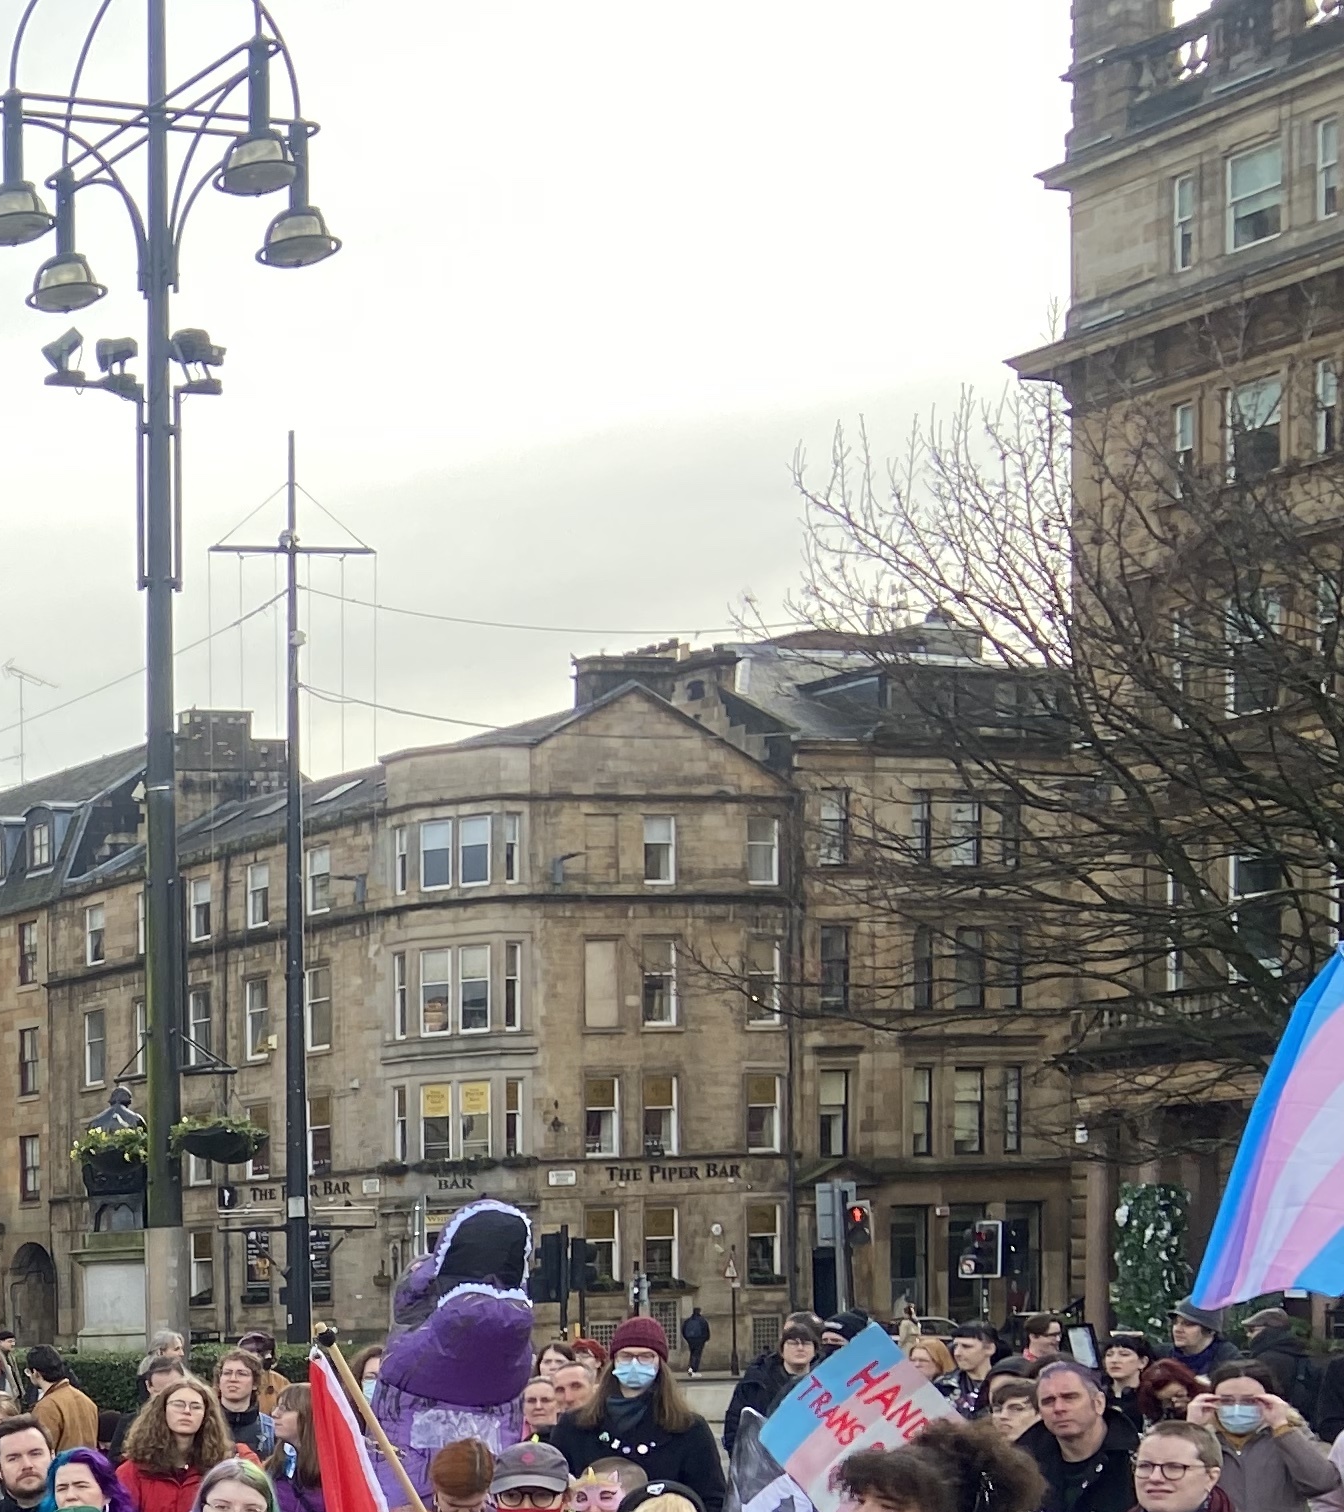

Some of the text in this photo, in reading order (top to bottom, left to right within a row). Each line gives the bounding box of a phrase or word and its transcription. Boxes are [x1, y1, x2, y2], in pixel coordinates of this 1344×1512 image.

[606, 1162, 742, 1183] THE PIPER BAR
[250, 1187, 276, 1202] THE
[323, 1180, 351, 1196] BAR
[438, 1177, 475, 1190] BAR
[798, 1374, 866, 1446] TRANS
